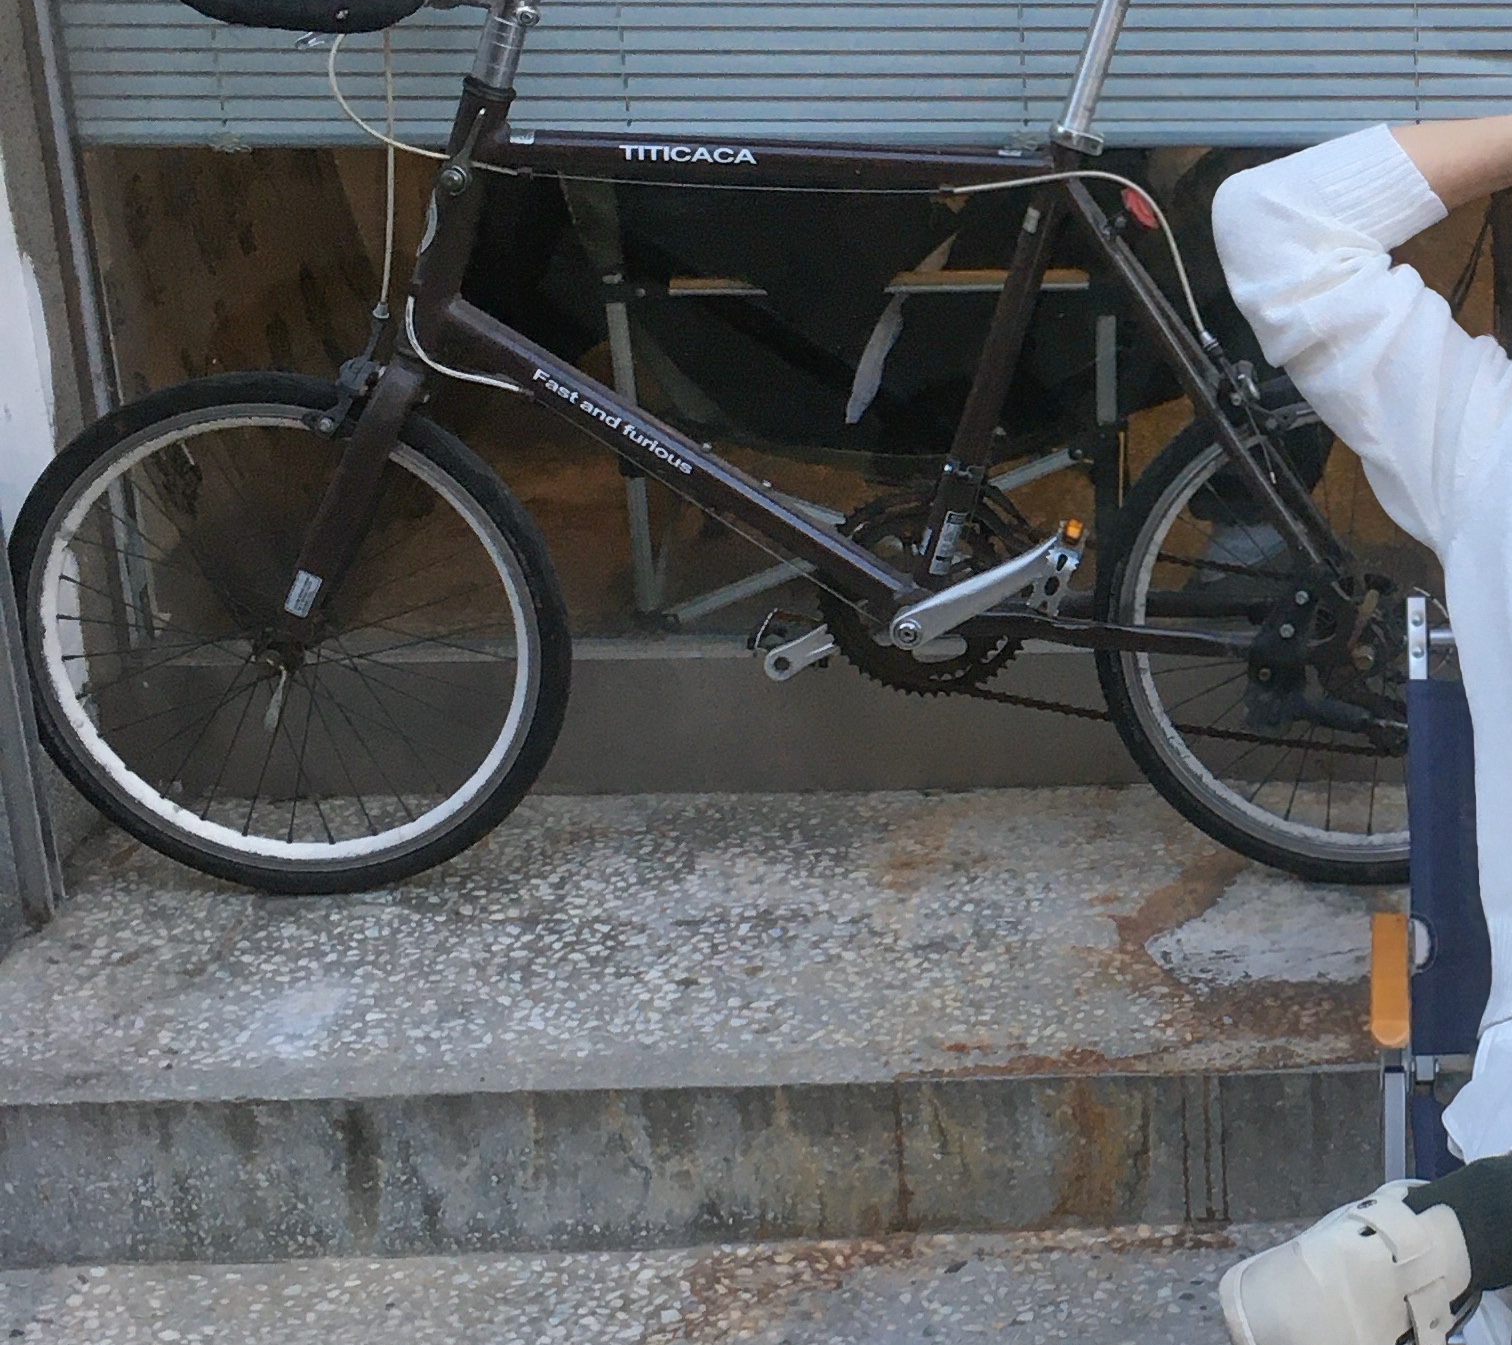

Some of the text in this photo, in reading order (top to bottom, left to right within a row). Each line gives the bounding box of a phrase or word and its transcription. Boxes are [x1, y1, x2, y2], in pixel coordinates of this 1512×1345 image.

[618, 144, 758, 165] TITICACA
[532, 368, 694, 475] Fast and furious
